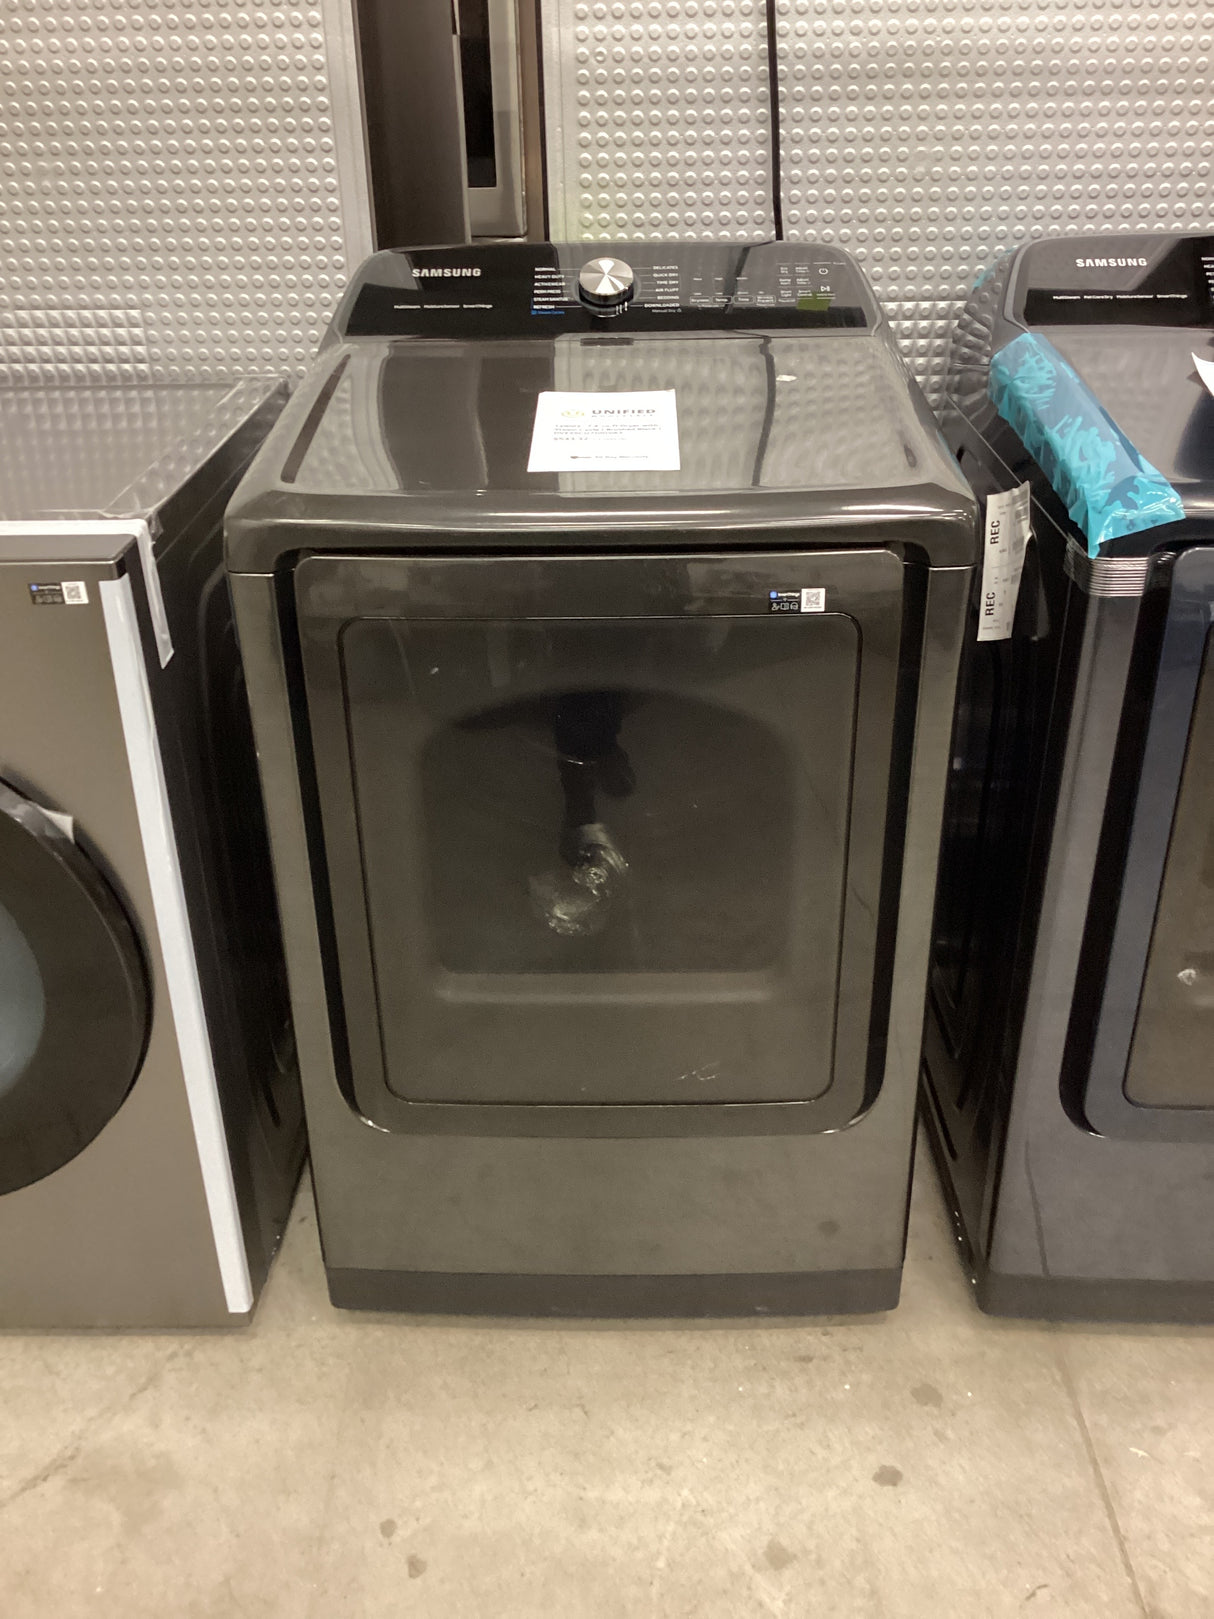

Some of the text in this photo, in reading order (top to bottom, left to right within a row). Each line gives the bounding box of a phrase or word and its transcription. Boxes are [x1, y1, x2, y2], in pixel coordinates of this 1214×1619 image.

[1075, 257, 1148, 267] SAMSUNG
[411, 268, 482, 278] SAMSUNG
[989, 519, 1001, 545] REC
[984, 591, 996, 616] REC
